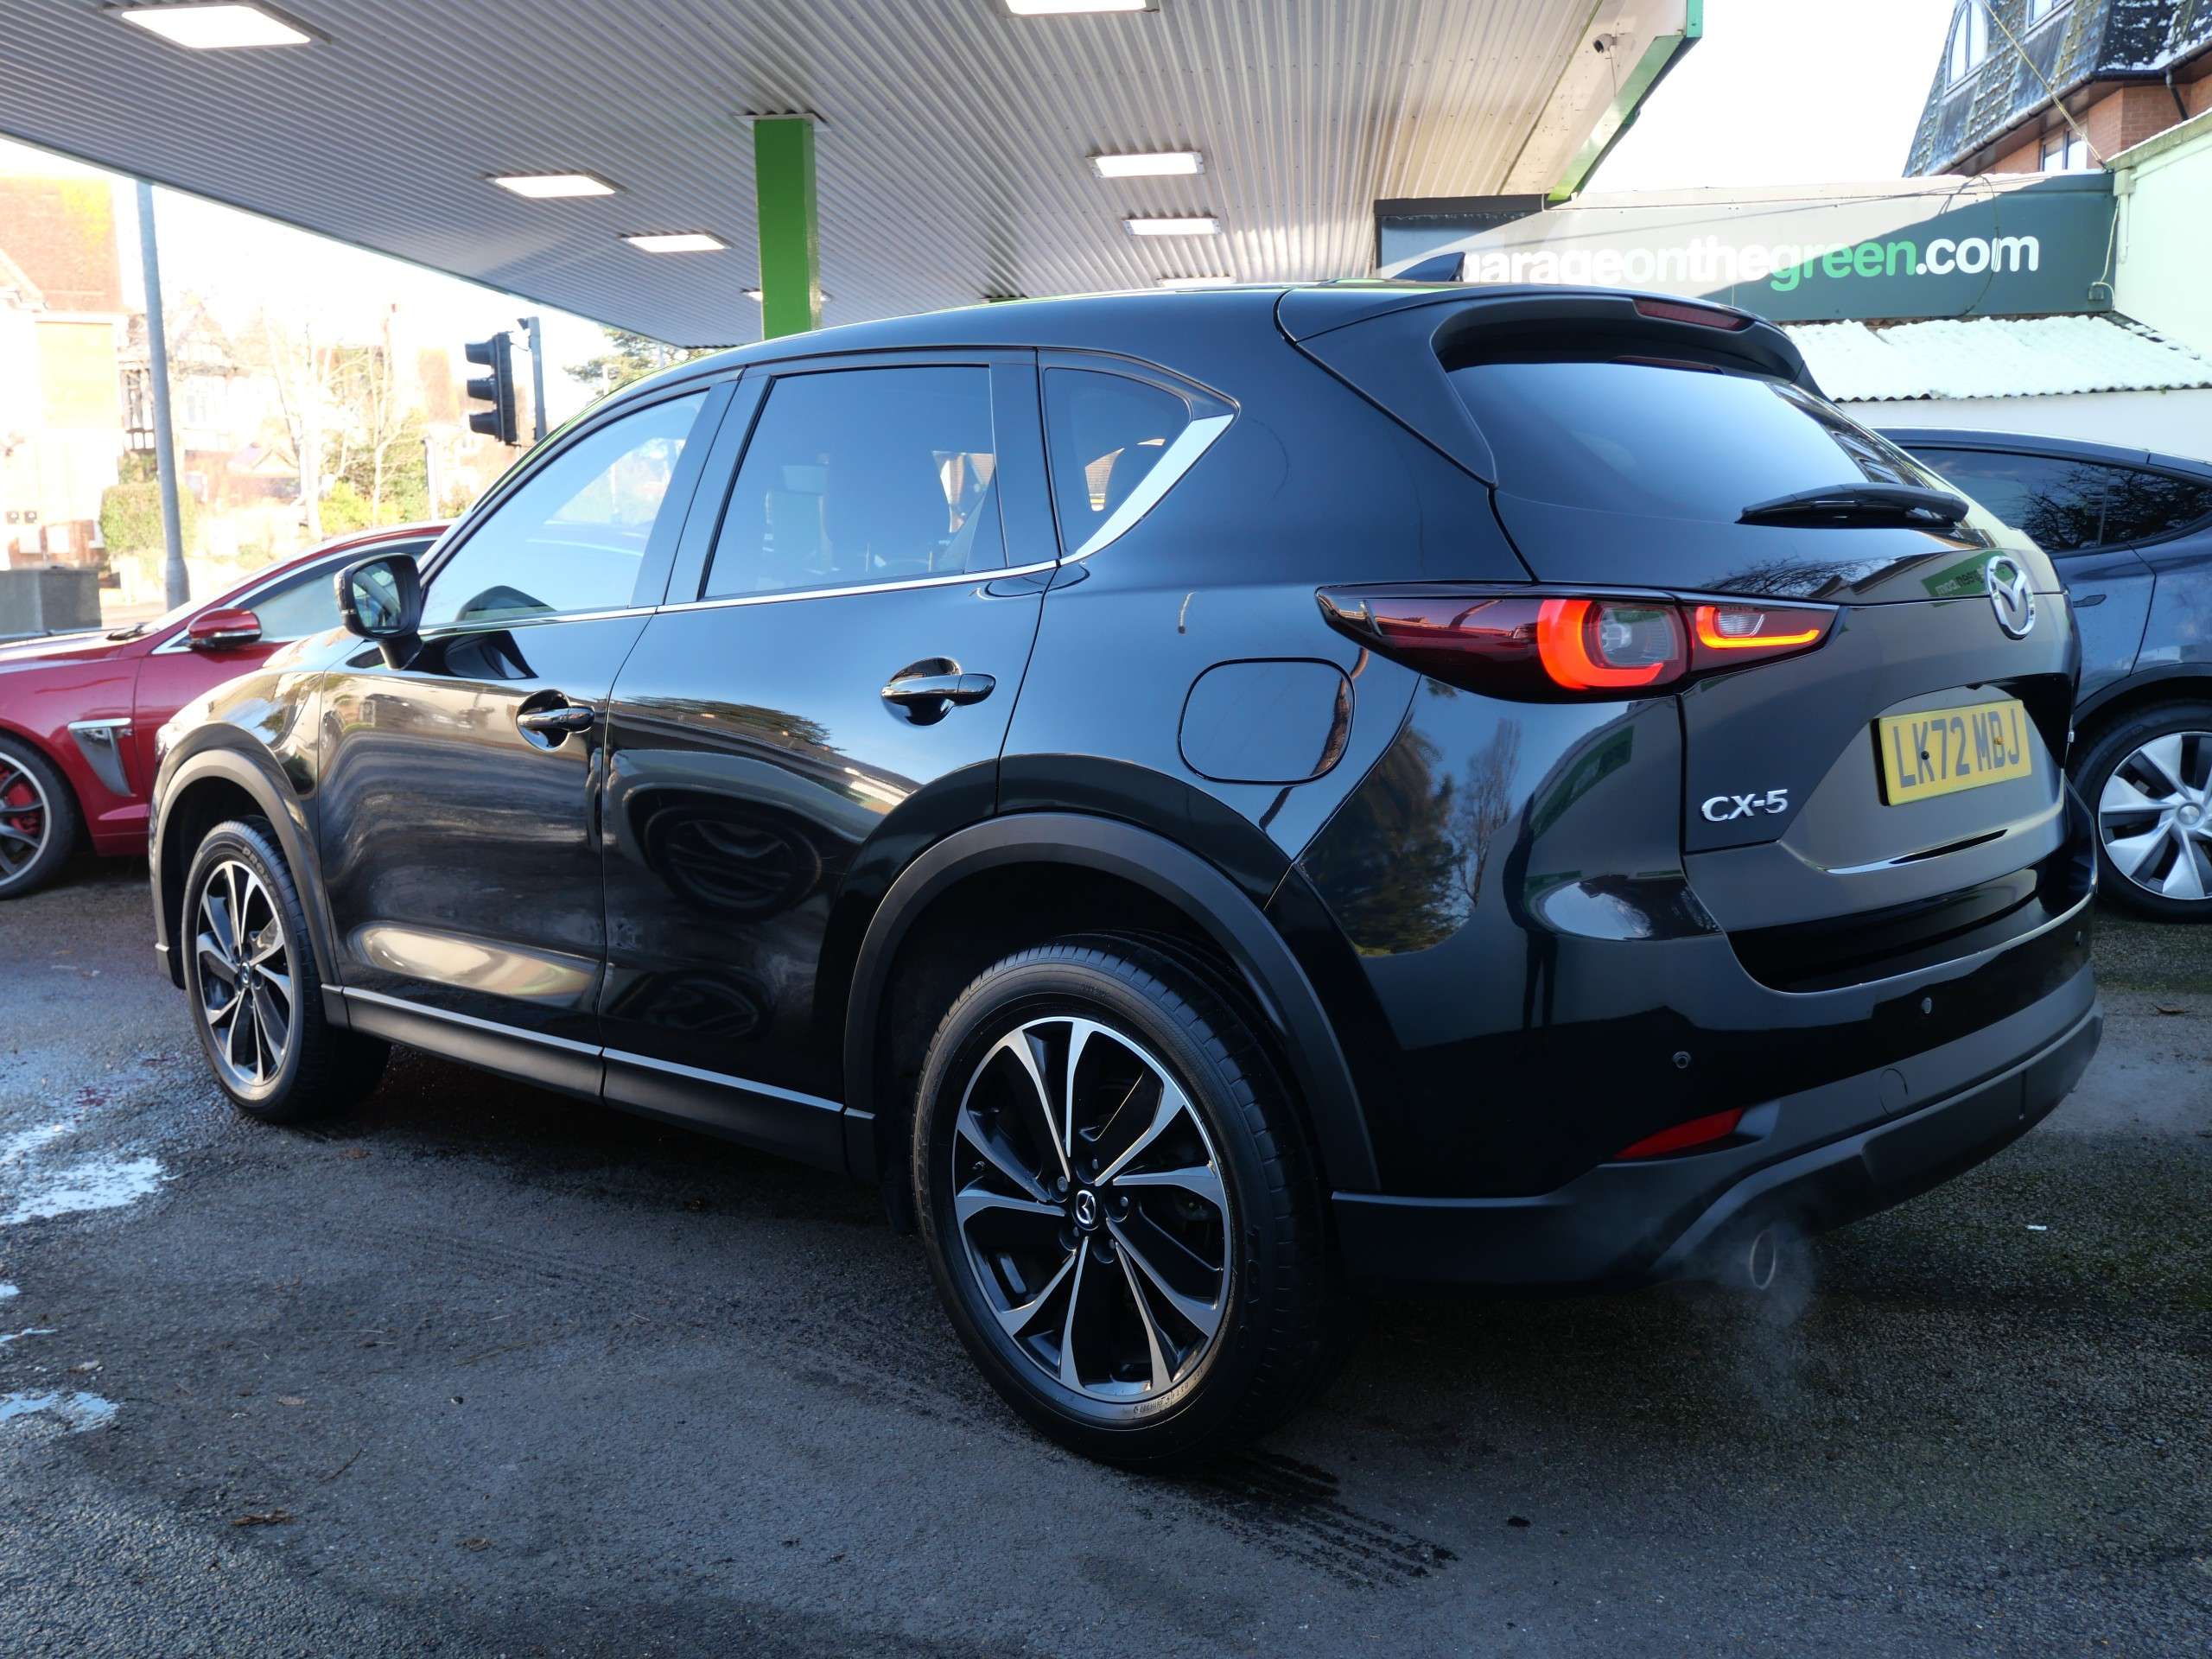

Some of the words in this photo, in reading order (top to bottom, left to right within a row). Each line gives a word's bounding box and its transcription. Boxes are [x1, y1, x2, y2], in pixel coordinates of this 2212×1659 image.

[1892, 716, 1970, 789] LK72
[1972, 708, 2021, 772] MBJ
[1701, 788, 1789, 822] CX-5
